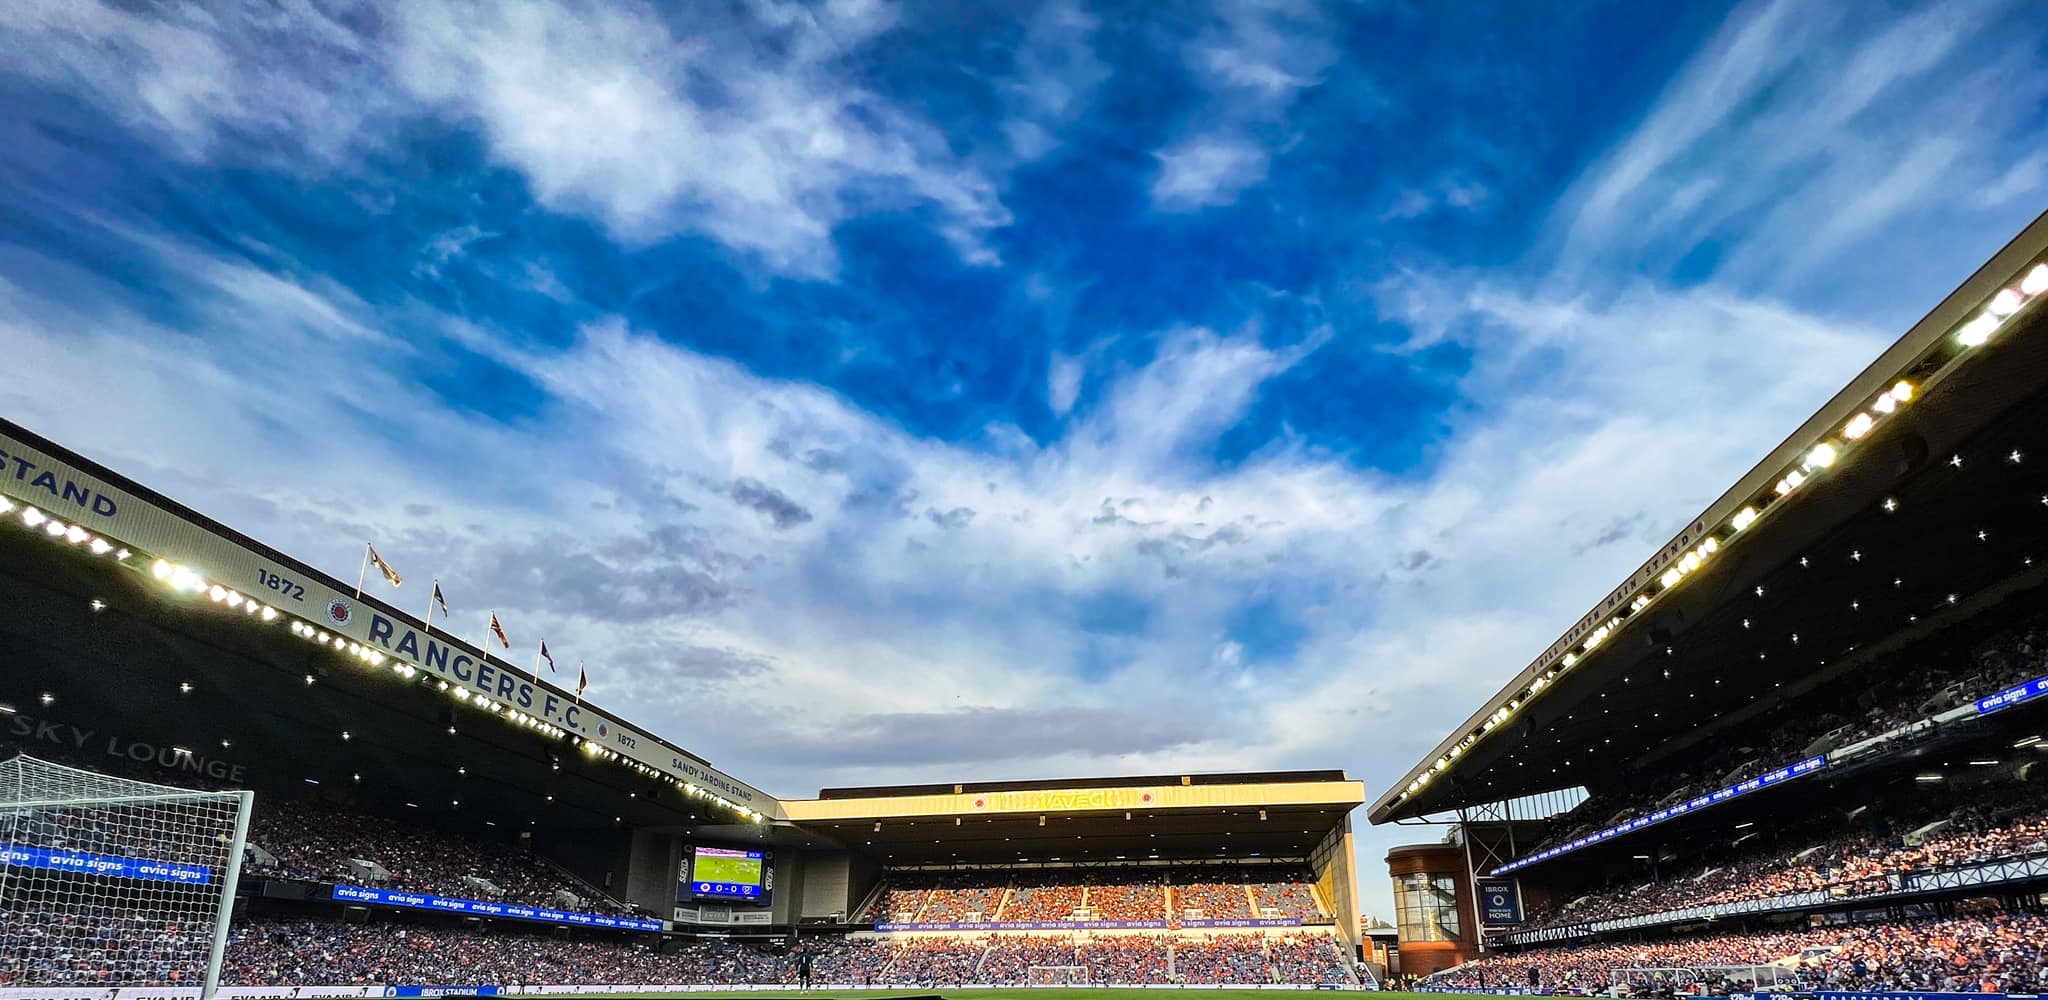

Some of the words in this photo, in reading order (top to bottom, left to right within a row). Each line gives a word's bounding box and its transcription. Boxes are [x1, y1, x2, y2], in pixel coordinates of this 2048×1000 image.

[258, 568, 305, 601] 1872
[1563, 610, 1600, 647] STRUTH
[1607, 578, 1637, 609] MAIN
[1645, 535, 1689, 577] STAND
[368, 614, 533, 708] RANGERS
[543, 694, 586, 733] F.C.
[1982, 695, 2002, 709] avia
[2003, 688, 2027, 702] signs
[617, 733, 636, 750] 1872
[10, 715, 94, 748] SKY
[106, 736, 247, 783] LOUNGE
[672, 758, 699, 778] SANDY
[700, 771, 730, 793] JARDINE
[731, 786, 752, 801] STAND
[50, 854, 84, 867] avia
[87, 857, 123, 871] signs
[140, 865, 168, 876] avia
[170, 866, 201, 880] signs
[338, 888, 357, 897] avia
[359, 889, 379, 900] signs
[730, 885, 737, 893] 0
[388, 893, 405, 902] avia
[406, 894, 425, 905] signs
[432, 898, 448, 907] avia
[449, 899, 465, 910] signs
[472, 903, 486, 911] avia
[486, 904, 501, 913] signs
[896, 922, 910, 931] signs
[934, 922, 950, 931] signs
[958, 921, 973, 929] avia
[974, 921, 991, 931] signs
[1000, 921, 1015, 929] avia
[1016, 921, 1033, 930] signs
[1057, 921, 1075, 930] signs
[1084, 920, 1099, 928] avia
[1100, 920, 1118, 929] signs
[1143, 920, 1161, 929] signs
[1186, 919, 1205, 928] signs
[1214, 919, 1230, 927] avia
[1231, 919, 1250, 928] signs
[1259, 918, 1275, 926] avia
[1277, 918, 1296, 927] signs
[421, 986, 443, 996] IBROX
[445, 986, 478, 996] STADIUM
